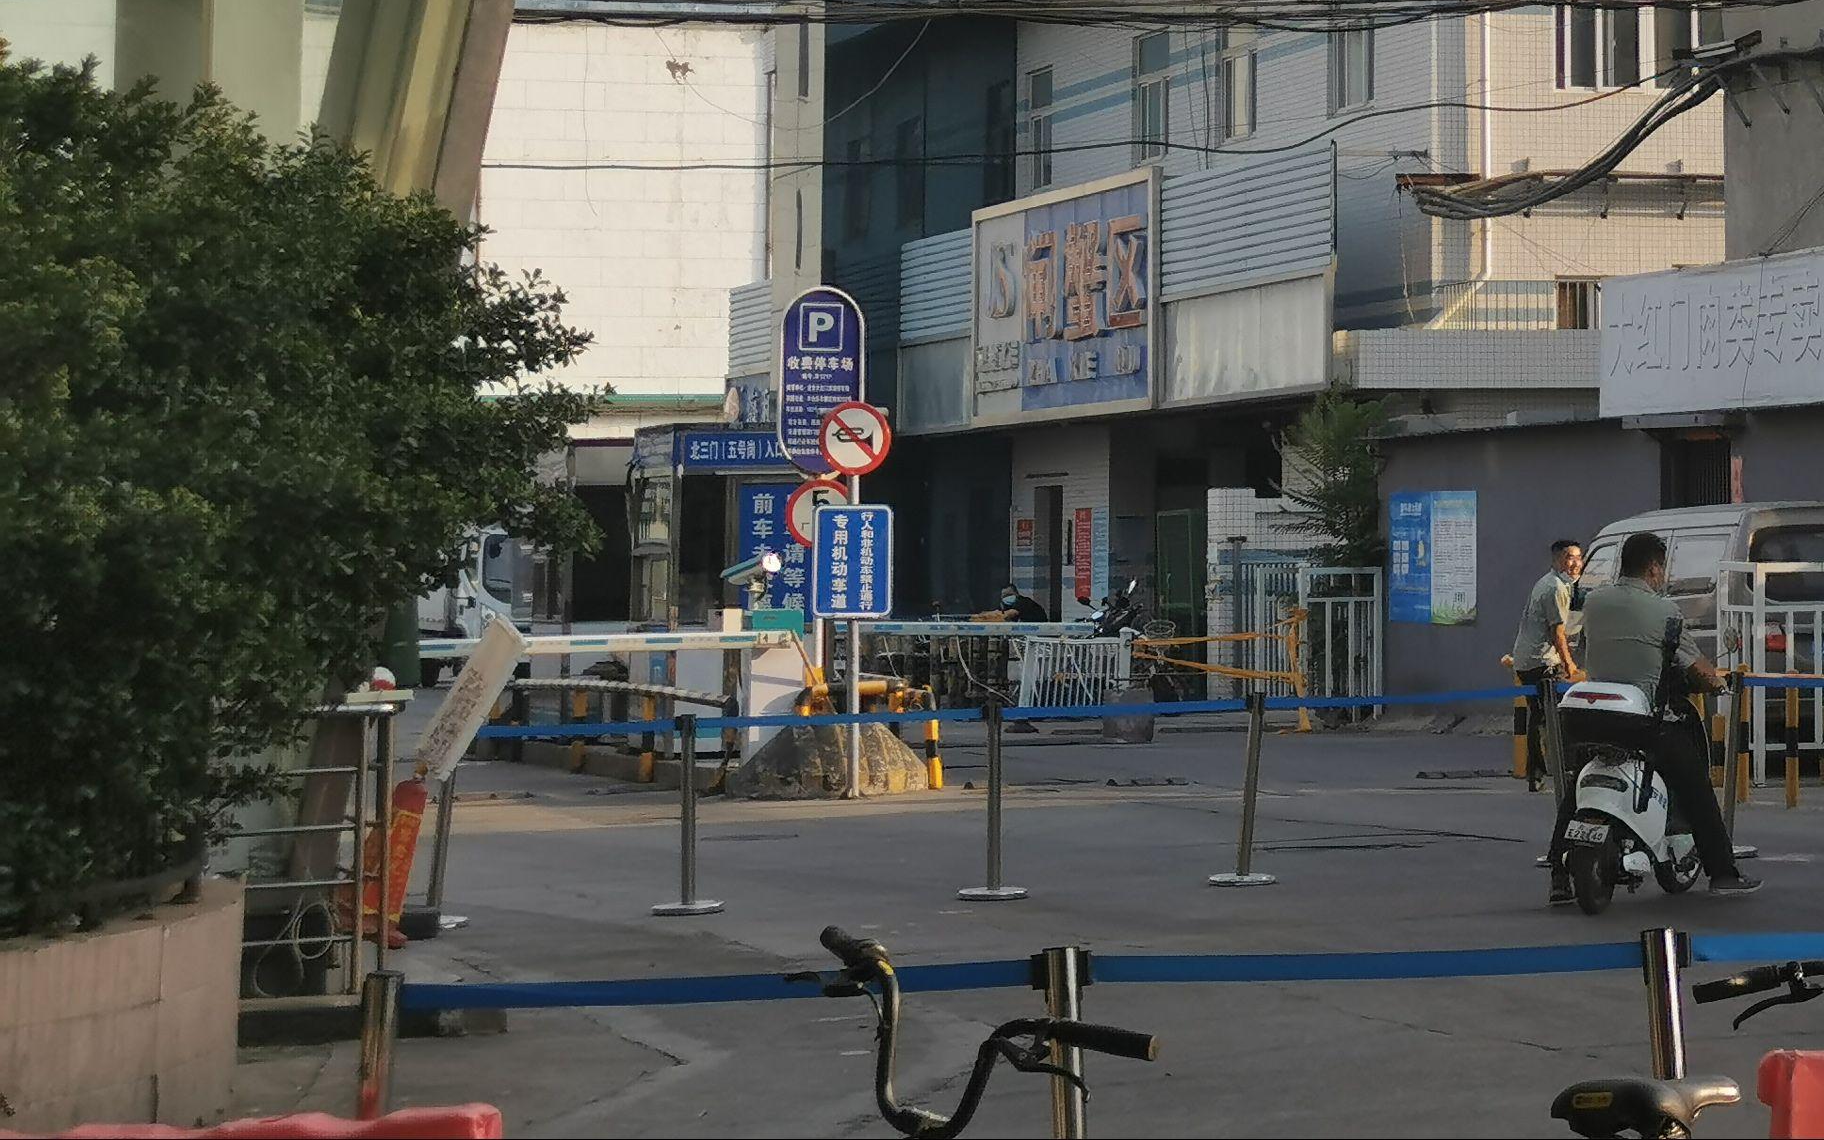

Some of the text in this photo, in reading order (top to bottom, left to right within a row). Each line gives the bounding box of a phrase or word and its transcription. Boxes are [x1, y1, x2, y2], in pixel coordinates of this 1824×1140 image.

[808, 311, 835, 343] P
[787, 356, 854, 372] 收费停车场
[831, 513, 849, 609] 专用机动车道
[859, 511, 874, 611] 行人和非机动车禁止通行
